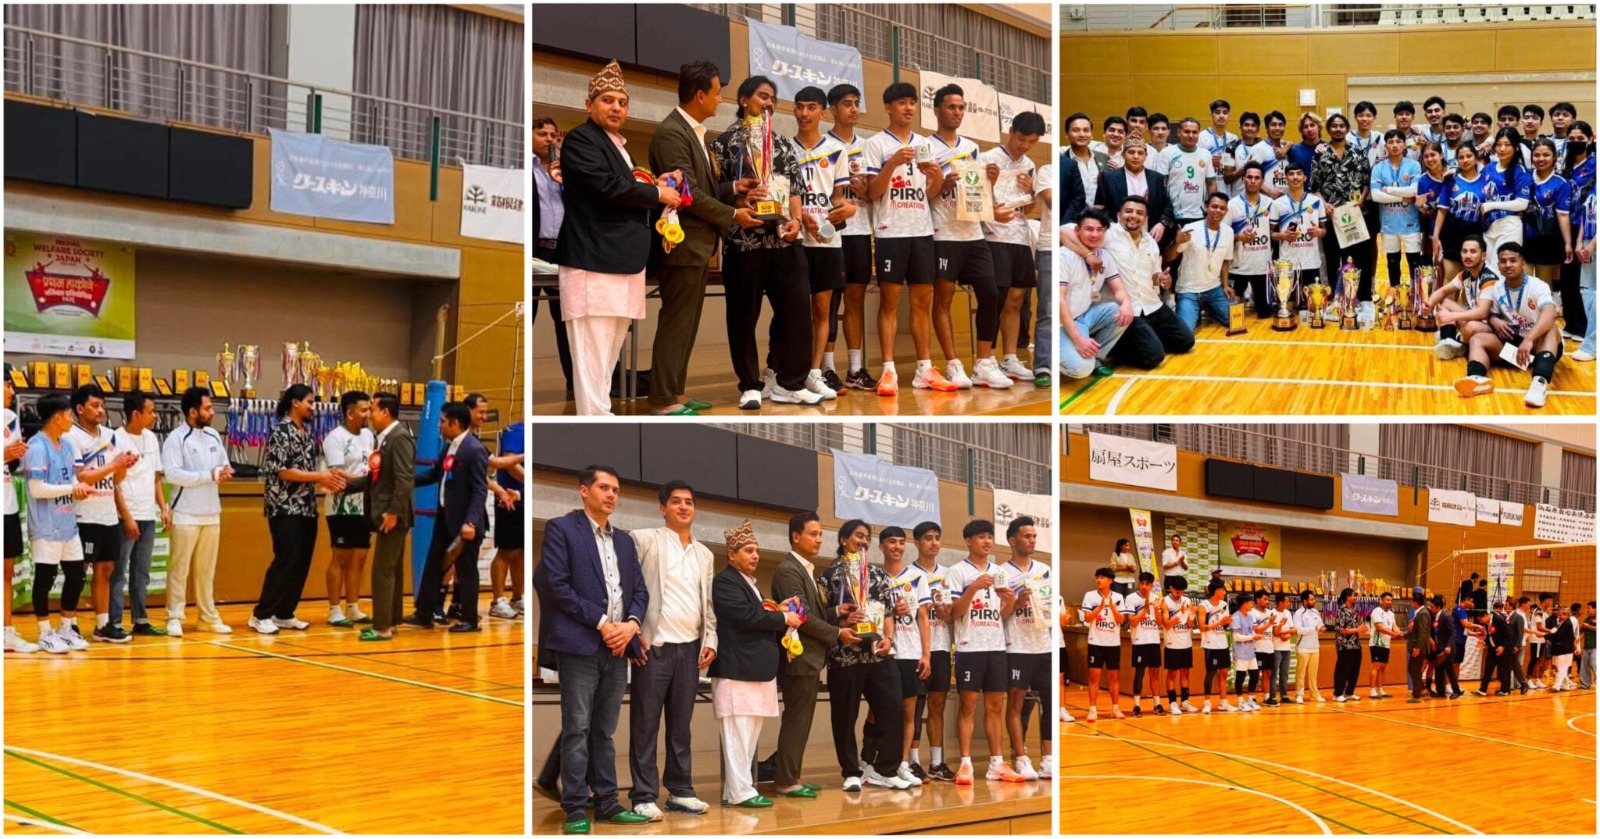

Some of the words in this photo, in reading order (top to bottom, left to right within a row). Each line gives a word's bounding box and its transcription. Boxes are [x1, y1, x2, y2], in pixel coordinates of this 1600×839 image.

[906, 162, 914, 176] 3
[1186, 165, 1195, 179] 9
[889, 187, 925, 202] PIRO
[33, 243, 71, 255] WELFARE
[73, 247, 104, 258] SOCIETY
[884, 259, 892, 273] 3
[938, 257, 949, 271] 14
[1091, 448, 1176, 474] 扇屋スポーツ
[970, 608, 1000, 621] PIRO
[1095, 620, 1116, 629] PIRO
[964, 670, 971, 682] 3
[1012, 669, 1021, 680] 14
